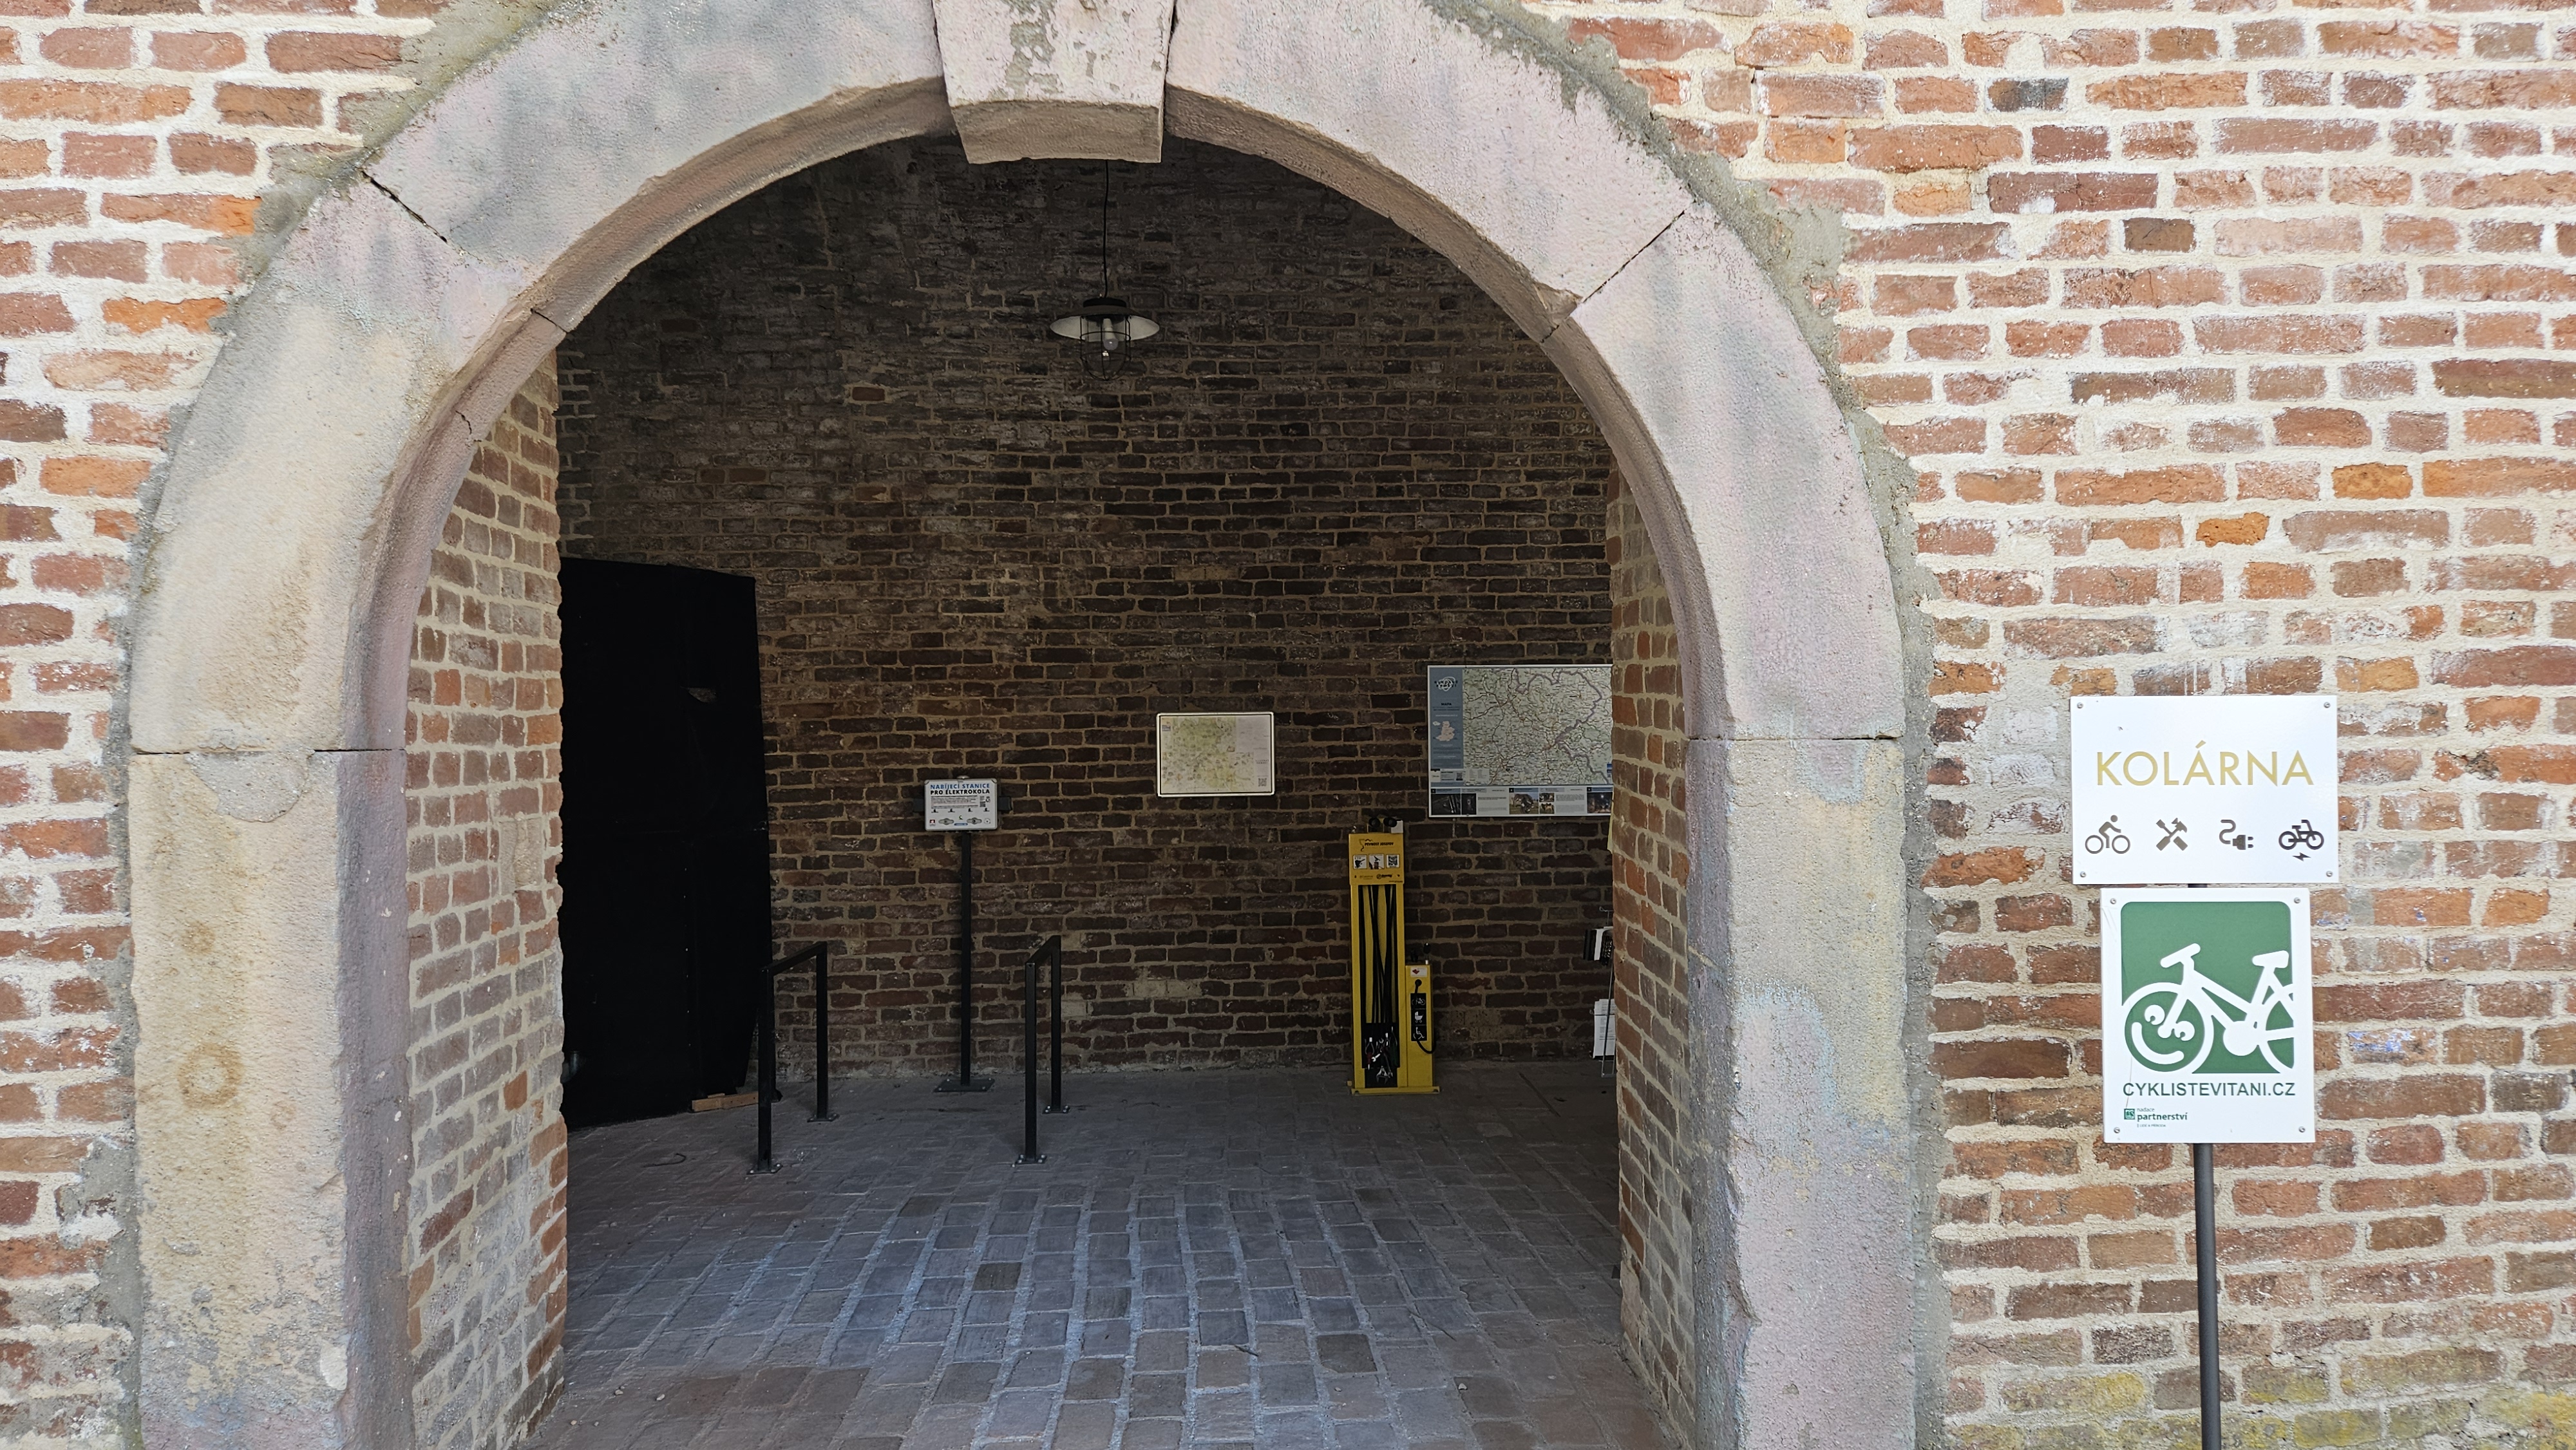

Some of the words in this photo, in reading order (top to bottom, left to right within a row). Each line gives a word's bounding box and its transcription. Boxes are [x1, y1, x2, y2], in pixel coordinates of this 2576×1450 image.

[2096, 740, 2314, 787] KOLÁRNA
[2123, 1082, 2296, 1096] CYKLISTEVITANI.CZ
[2137, 1112, 2188, 1122] partnerství
